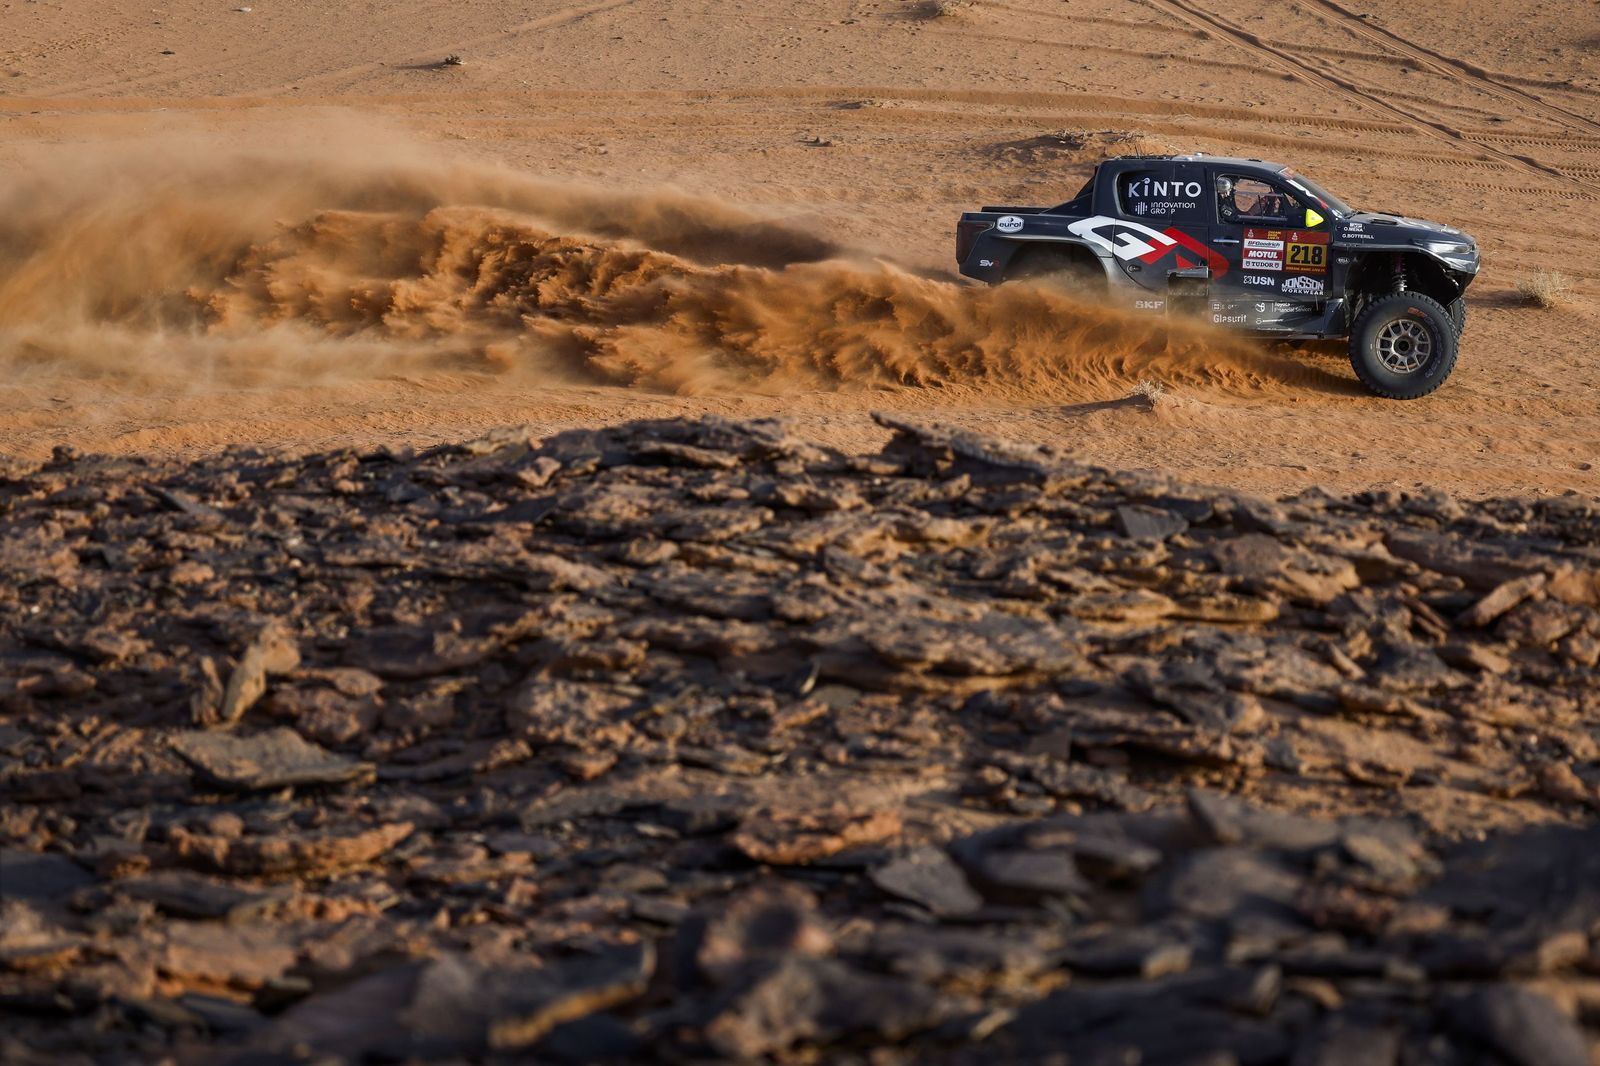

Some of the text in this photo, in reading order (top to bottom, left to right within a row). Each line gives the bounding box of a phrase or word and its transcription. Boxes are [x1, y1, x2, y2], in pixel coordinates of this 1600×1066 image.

[1150, 207, 1176, 215] GROP
[1247, 240, 1281, 248] BFGoodrich
[1247, 250, 1279, 259] MOTUL
[1290, 244, 1323, 265] 218
[1252, 276, 1275, 286] USN
[1281, 275, 1324, 290] JONSSON
[1281, 288, 1324, 296] WORKWEAR
[1135, 300, 1164, 309] SKF
